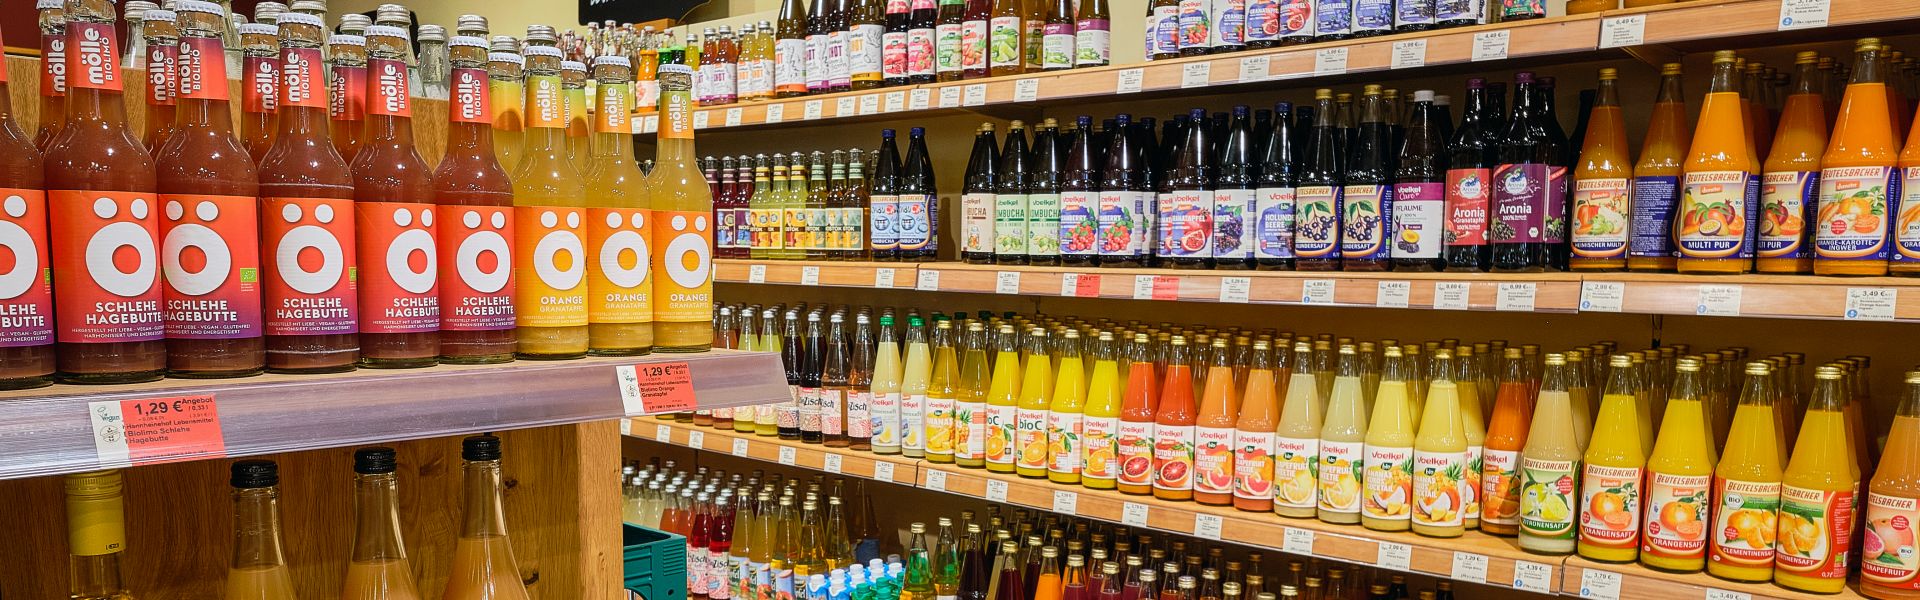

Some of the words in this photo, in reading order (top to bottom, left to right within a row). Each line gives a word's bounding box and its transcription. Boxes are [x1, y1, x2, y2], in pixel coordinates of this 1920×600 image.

[80, 28, 104, 85] mölle
[100, 37, 113, 81] BIOLIMÖ
[178, 41, 192, 94] mölle
[189, 49, 201, 91] BIOLIMÖ
[150, 50, 166, 101] mölle
[163, 57, 176, 97] BIOLIMÖ
[284, 52, 301, 102] mölle
[298, 59, 310, 99] BIOLIMÖ
[256, 61, 275, 110] mölle
[381, 63, 398, 113] mölle
[396, 71, 406, 110] BIOLIMÖ
[458, 72, 474, 119] mölle
[472, 79, 482, 116] BIOLIMÖ
[536, 79, 552, 122] mölle
[604, 87, 618, 127] mölle
[668, 94, 682, 133] mölle
[1686, 172, 1741, 183] BEUTELSBACHER
[1822, 169, 1880, 180] BEUTELSBACHER
[1577, 180, 1625, 190] BEUTELSBACHER
[1453, 206, 1486, 218] Aronia
[1499, 203, 1532, 215] Aronia
[1688, 241, 1712, 249] MULTI
[1714, 241, 1730, 249] PUR
[1767, 241, 1782, 249] PUR
[283, 297, 342, 308] SCHLEHE
[393, 296, 437, 307] SCHLEHE
[463, 296, 510, 306] SCHLEHE
[540, 296, 583, 305] ORANGE
[606, 293, 647, 302] ORANGE
[670, 293, 708, 302] ORANGE
[95, 300, 157, 313] SCHLEHE
[168, 300, 228, 311] SCHLEHE
[455, 305, 514, 316] HAGEBUTTE
[86, 312, 162, 325] HAGEBUTTE
[164, 311, 238, 322] HAGEBUTTE
[276, 308, 349, 319] HAGEBUTTE
[643, 366, 663, 378] 1,29
[665, 366, 671, 376] €
[134, 402, 169, 416] 1,29
[172, 400, 183, 413] €
[181, 397, 213, 405] Angebot
[173, 417, 214, 426] Lebensmittel
[1020, 413, 1043, 421] Voelkel
[1120, 426, 1145, 435] Voelkel
[1157, 429, 1183, 438] Voelkel
[129, 436, 169, 444] Hagebutte
[1200, 432, 1228, 441] Voelkel
[1238, 436, 1266, 445] Voelkel
[1278, 443, 1305, 451] Voelkel
[1322, 446, 1349, 455] Voelkel
[1372, 451, 1404, 460] Voelkel
[1417, 457, 1448, 466] Voelkel
[1524, 459, 1570, 471] BEUTELSBACHER
[1588, 465, 1637, 477] BEUTELSBACHER
[1656, 474, 1707, 487] BEUTELSBACHER
[1584, 527, 1632, 538] ORANGENSAFT
[1652, 538, 1702, 549] ORANGENSAFT
